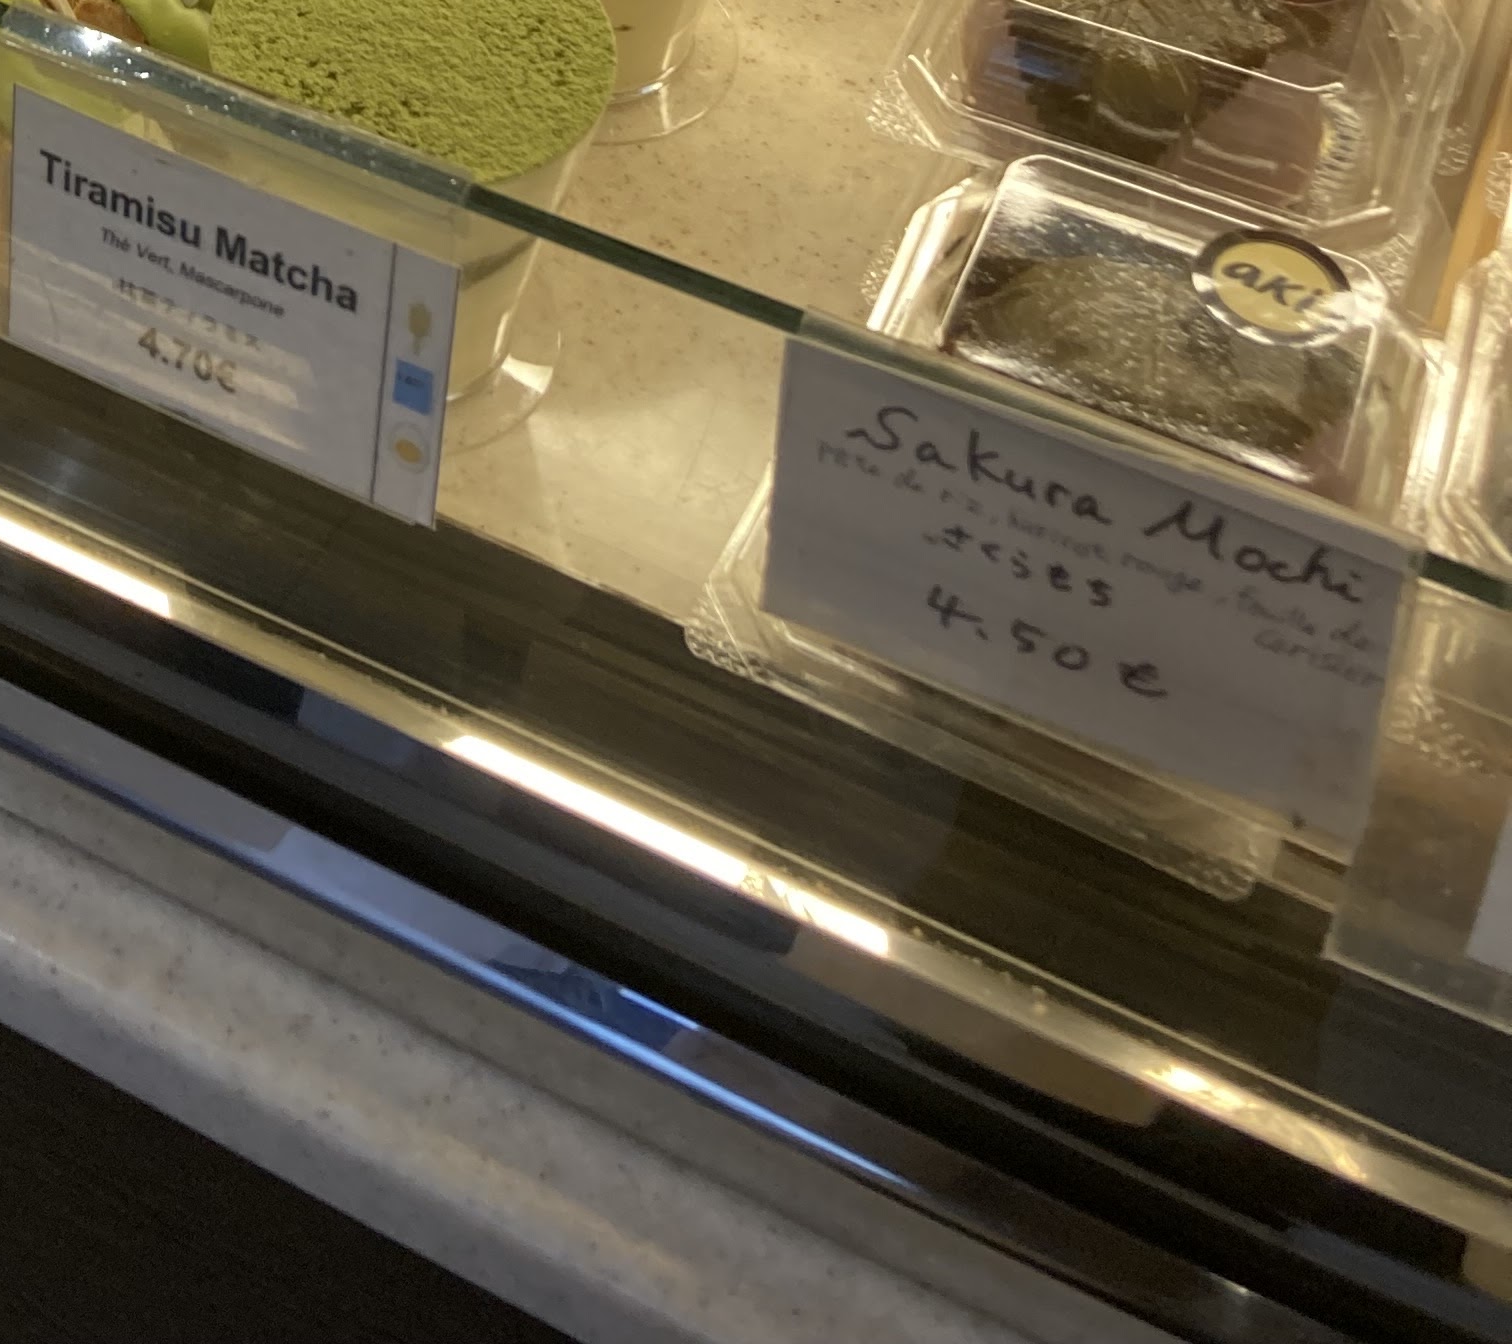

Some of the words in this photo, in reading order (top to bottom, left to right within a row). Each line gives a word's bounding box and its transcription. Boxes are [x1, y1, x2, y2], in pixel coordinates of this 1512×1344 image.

[39, 149, 201, 248] Tiramisu
[214, 226, 359, 313] Matcha
[137, 327, 237, 393] 4.70€
[845, 406, 1113, 526] Sakura
[1143, 500, 1363, 605] Mochi
